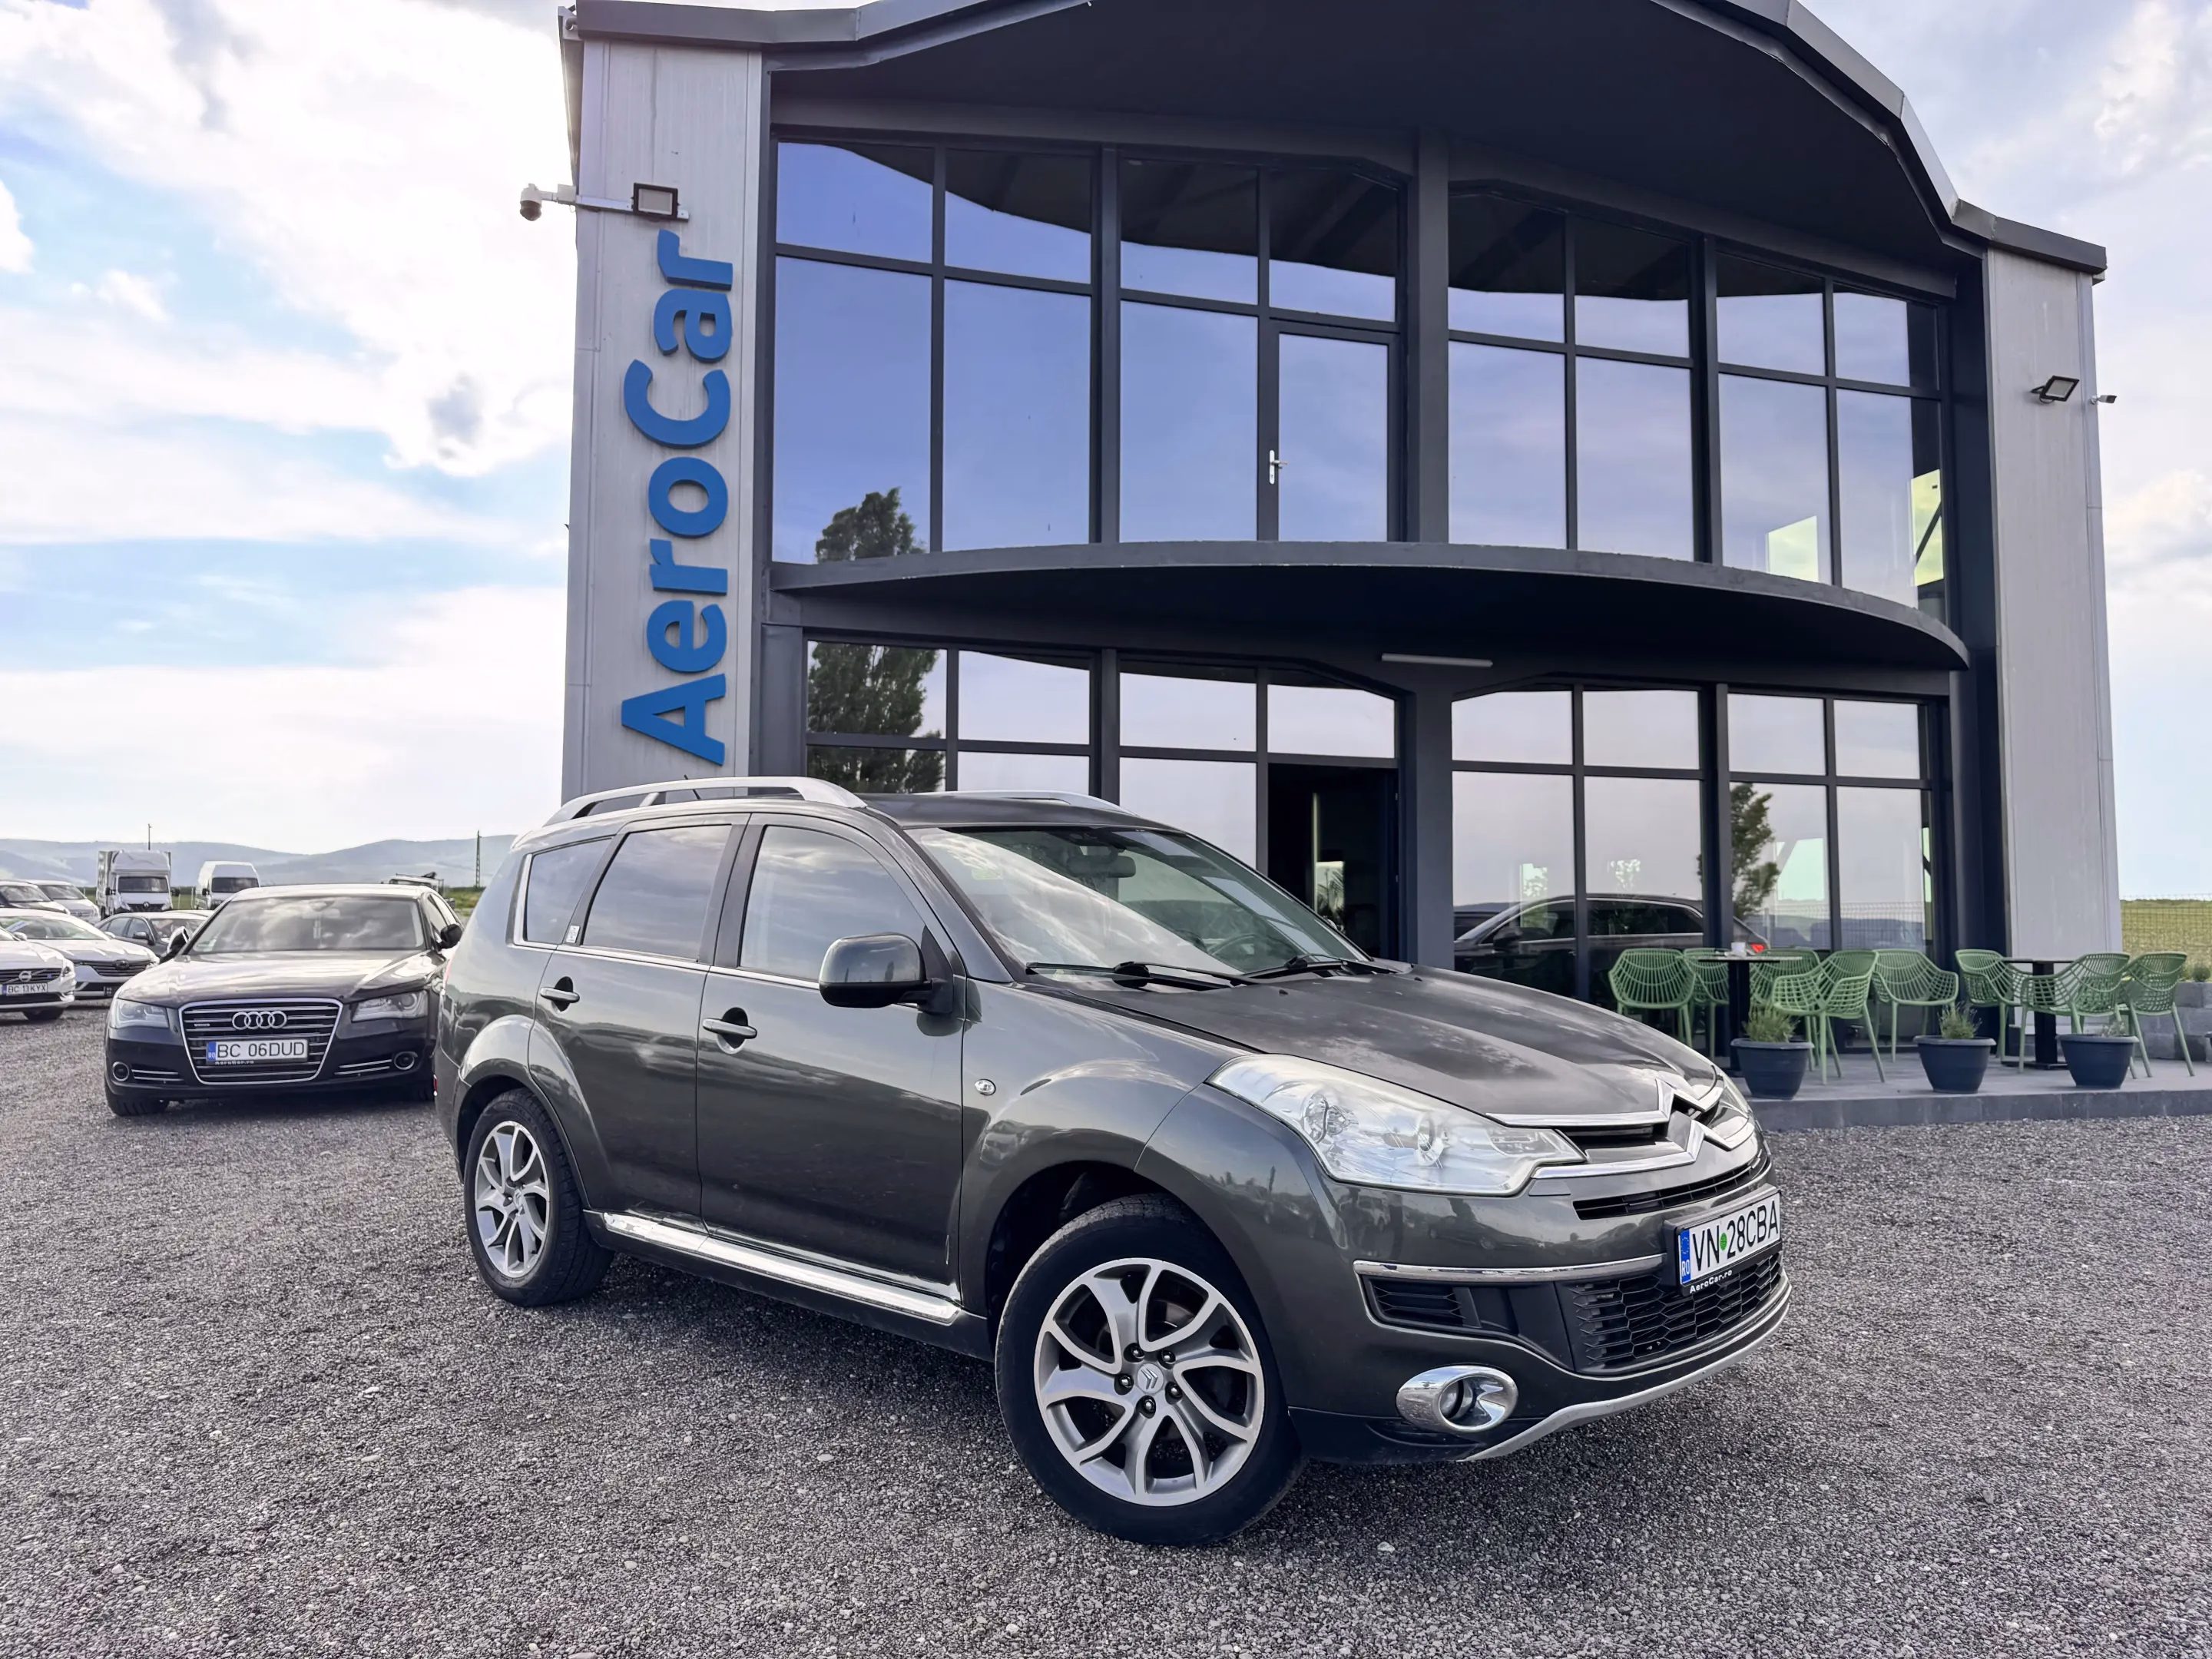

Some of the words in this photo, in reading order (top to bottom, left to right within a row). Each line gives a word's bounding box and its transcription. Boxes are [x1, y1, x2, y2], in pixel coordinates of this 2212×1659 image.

[621, 230, 733, 766] AeroCar
[217, 1043, 241, 1058] BC
[248, 1041, 304, 1057] 06DUD
[1693, 1225, 1720, 1271] VN
[1726, 1200, 1779, 1259] 28CBA
[1681, 1260, 1690, 1277] RO
[1690, 1270, 1733, 1294] AeroCar.ro
